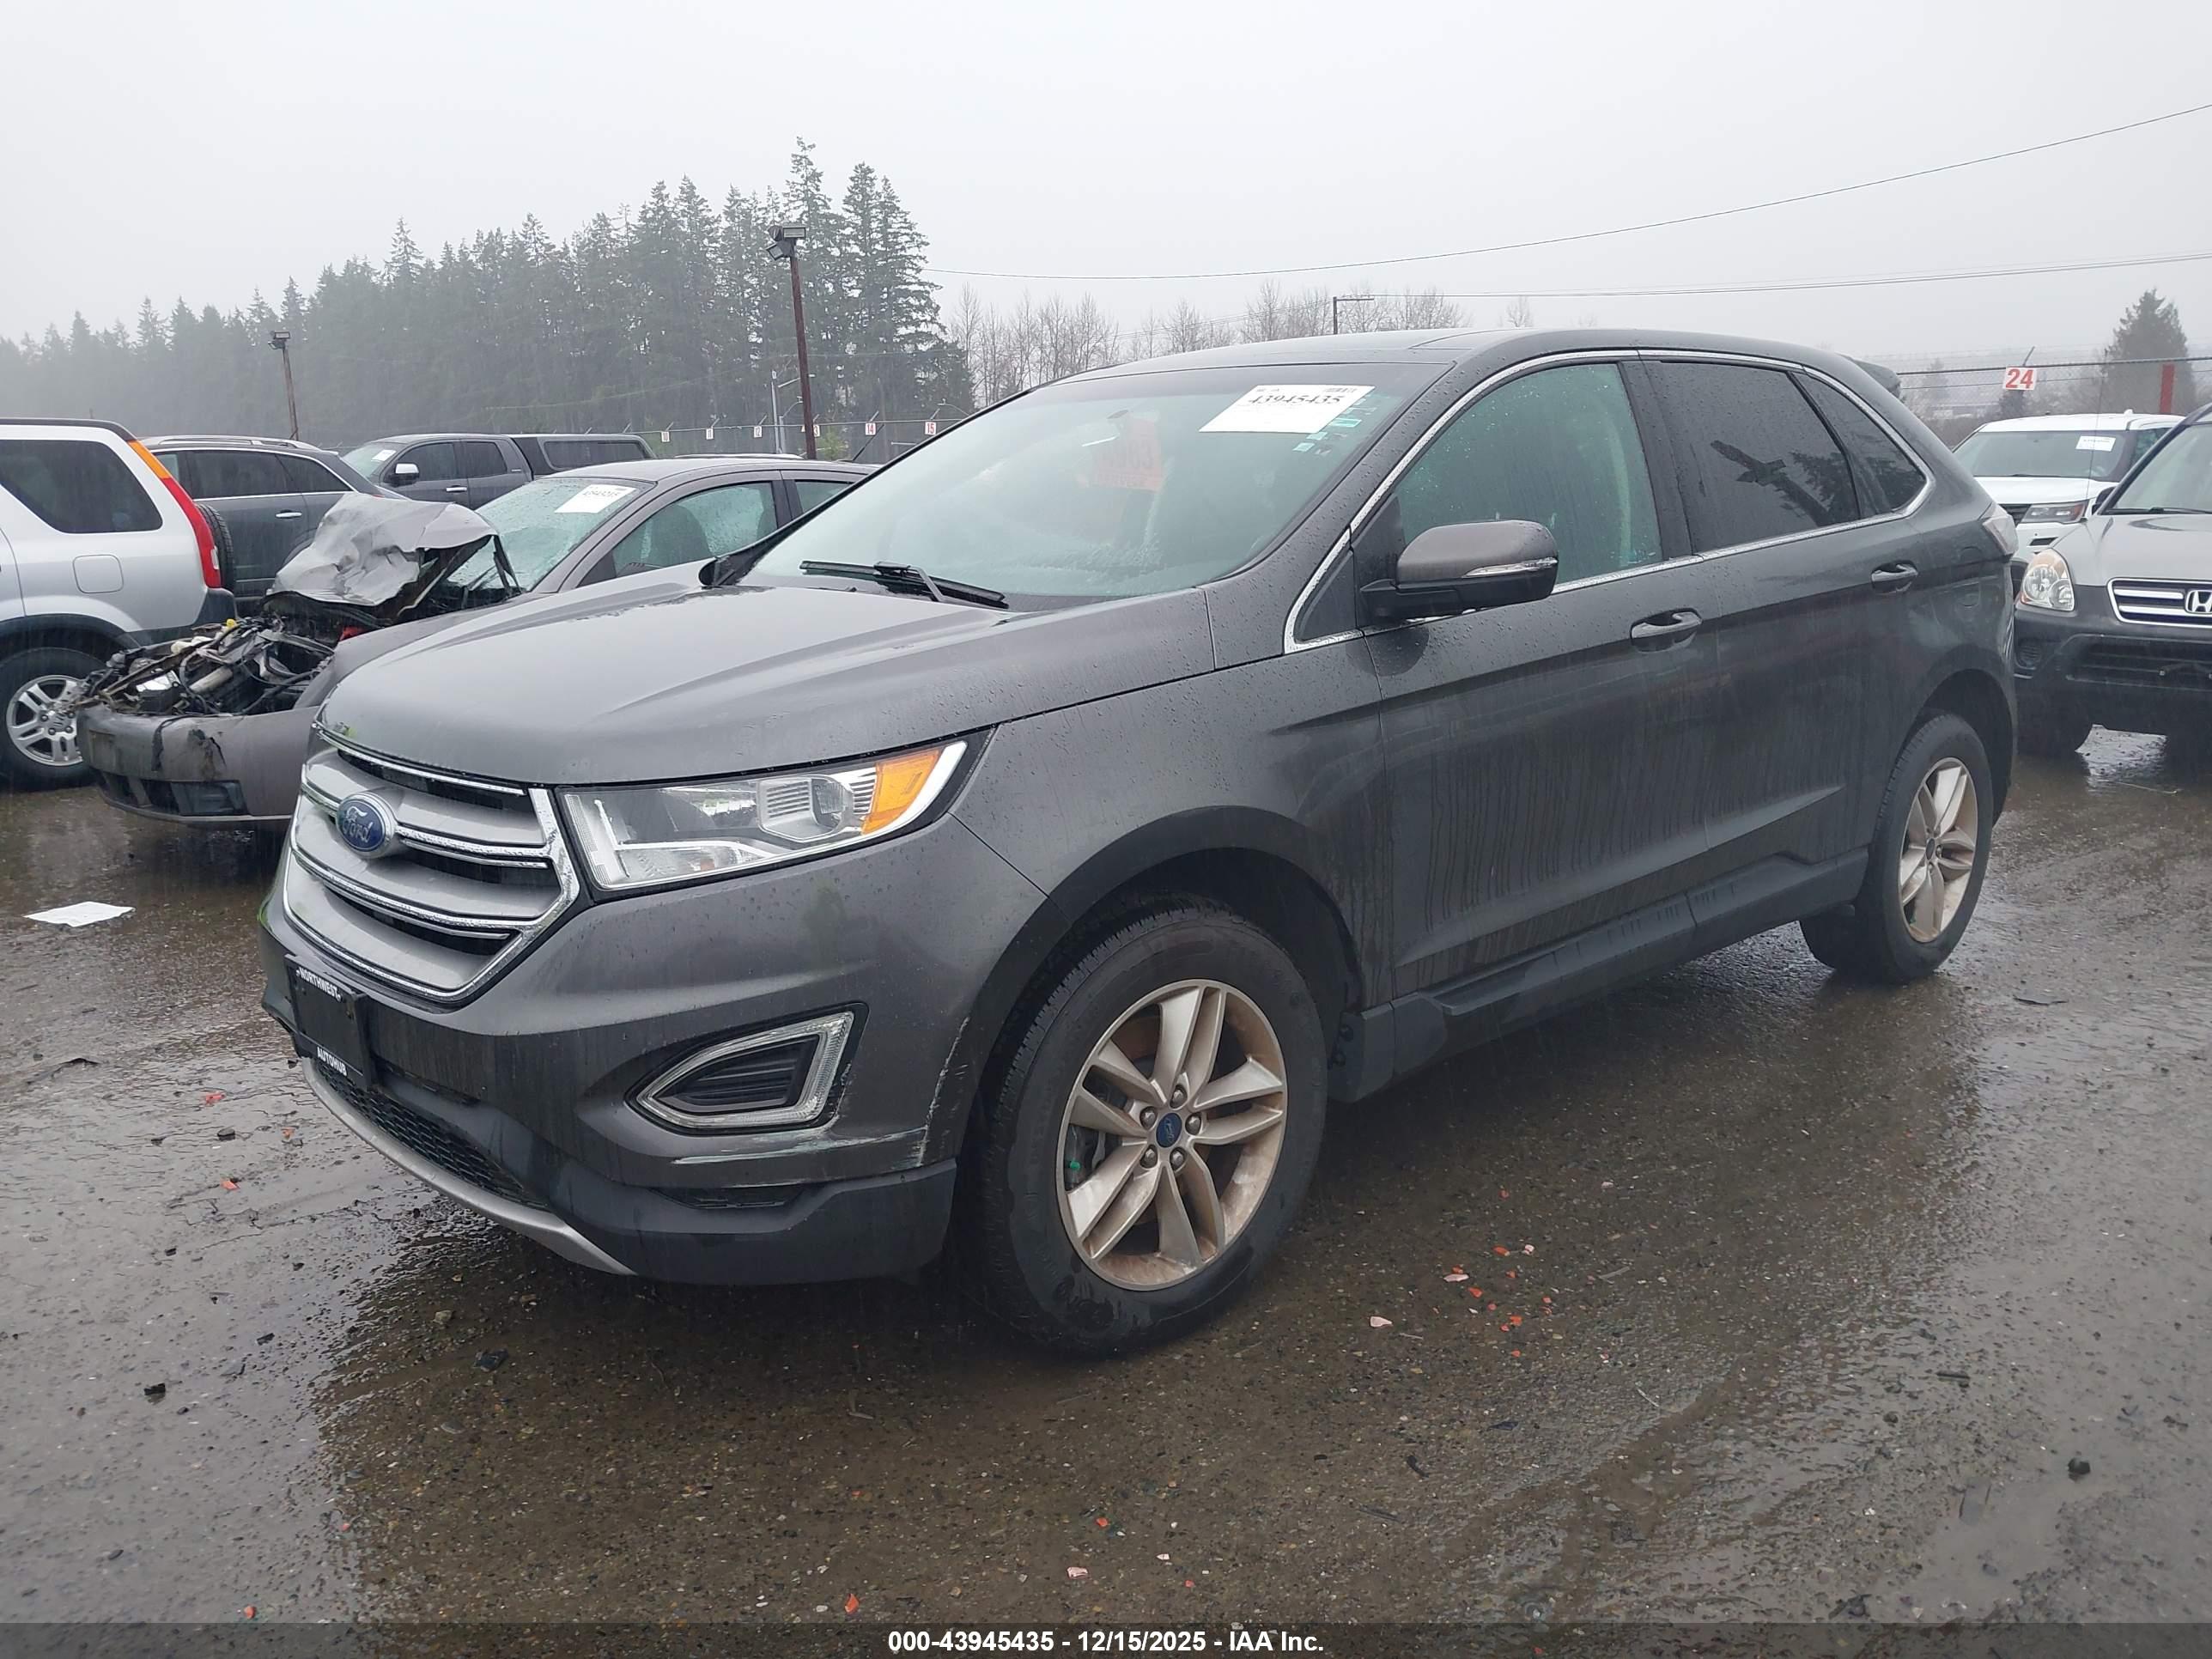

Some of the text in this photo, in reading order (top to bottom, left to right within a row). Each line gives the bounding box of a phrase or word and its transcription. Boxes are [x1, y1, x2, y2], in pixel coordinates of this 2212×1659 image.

[2005, 368, 2034, 389] 24
[1249, 394, 1346, 404] 43945435
[866, 423, 874, 434] 14
[927, 422, 935, 434] 15
[343, 805, 374, 843] Ford
[300, 966, 338, 998] NORTHWEST
[317, 1046, 348, 1077] AUTOHUB
